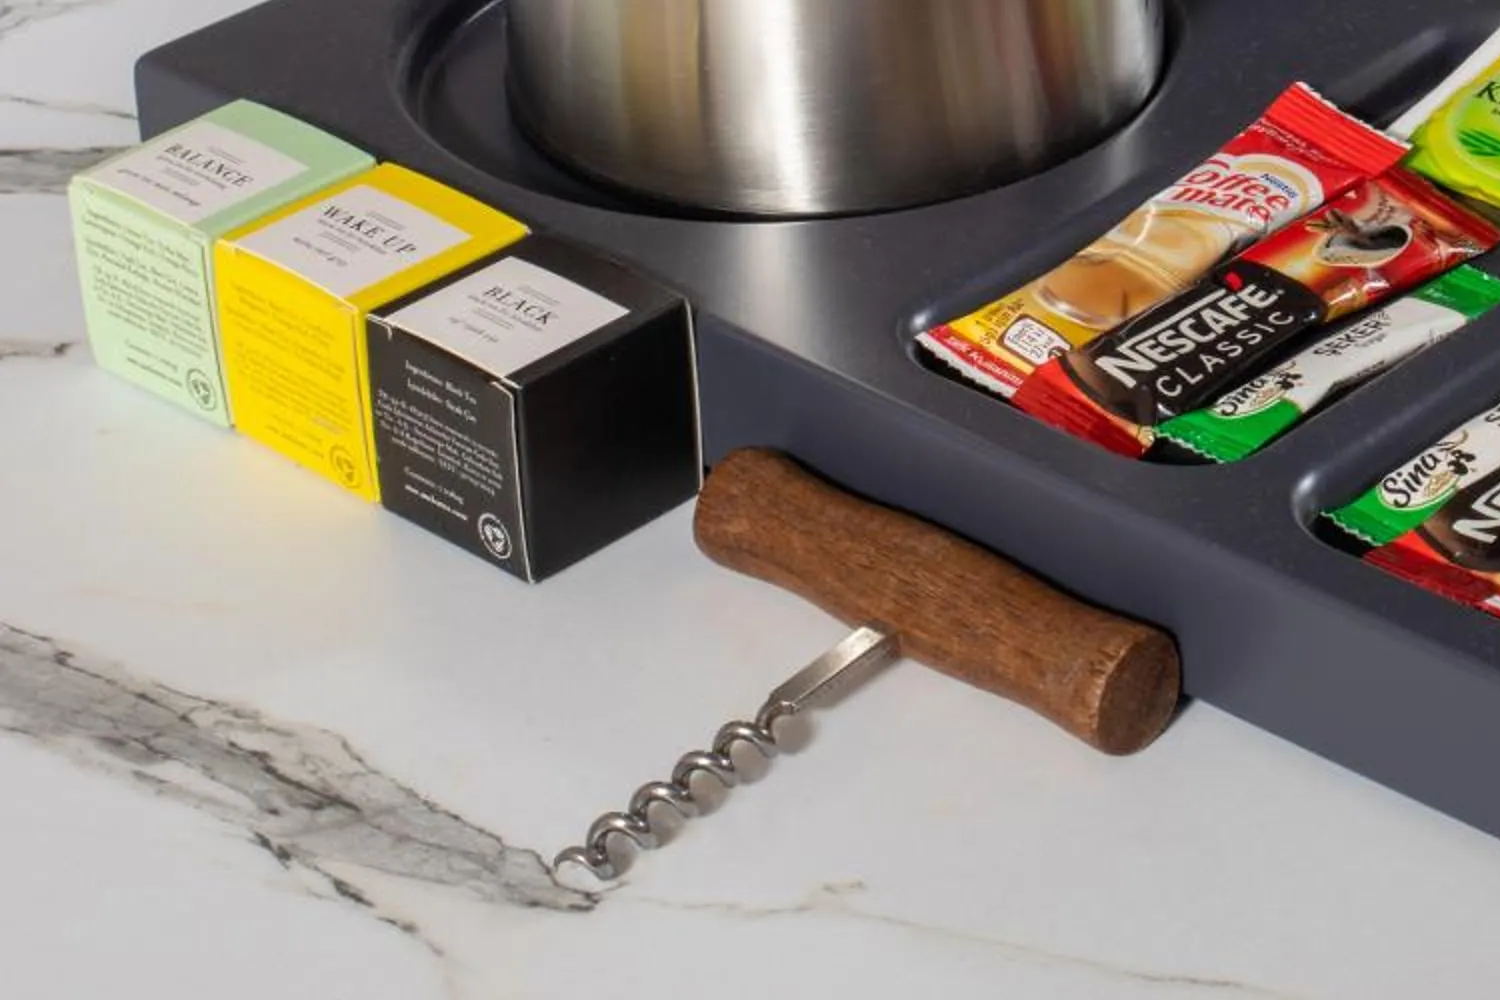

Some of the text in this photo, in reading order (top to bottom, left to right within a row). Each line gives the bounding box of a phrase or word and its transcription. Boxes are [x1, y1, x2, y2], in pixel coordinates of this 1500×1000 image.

[164, 143, 255, 187] BALANCE
[324, 205, 385, 239] WAKE
[383, 235, 417, 253] UP
[483, 286, 560, 325] BLACK
[1155, 311, 1295, 397] CLASSIC
[1313, 319, 1391, 356] ŞEKER
[1383, 453, 1442, 508] Sina
